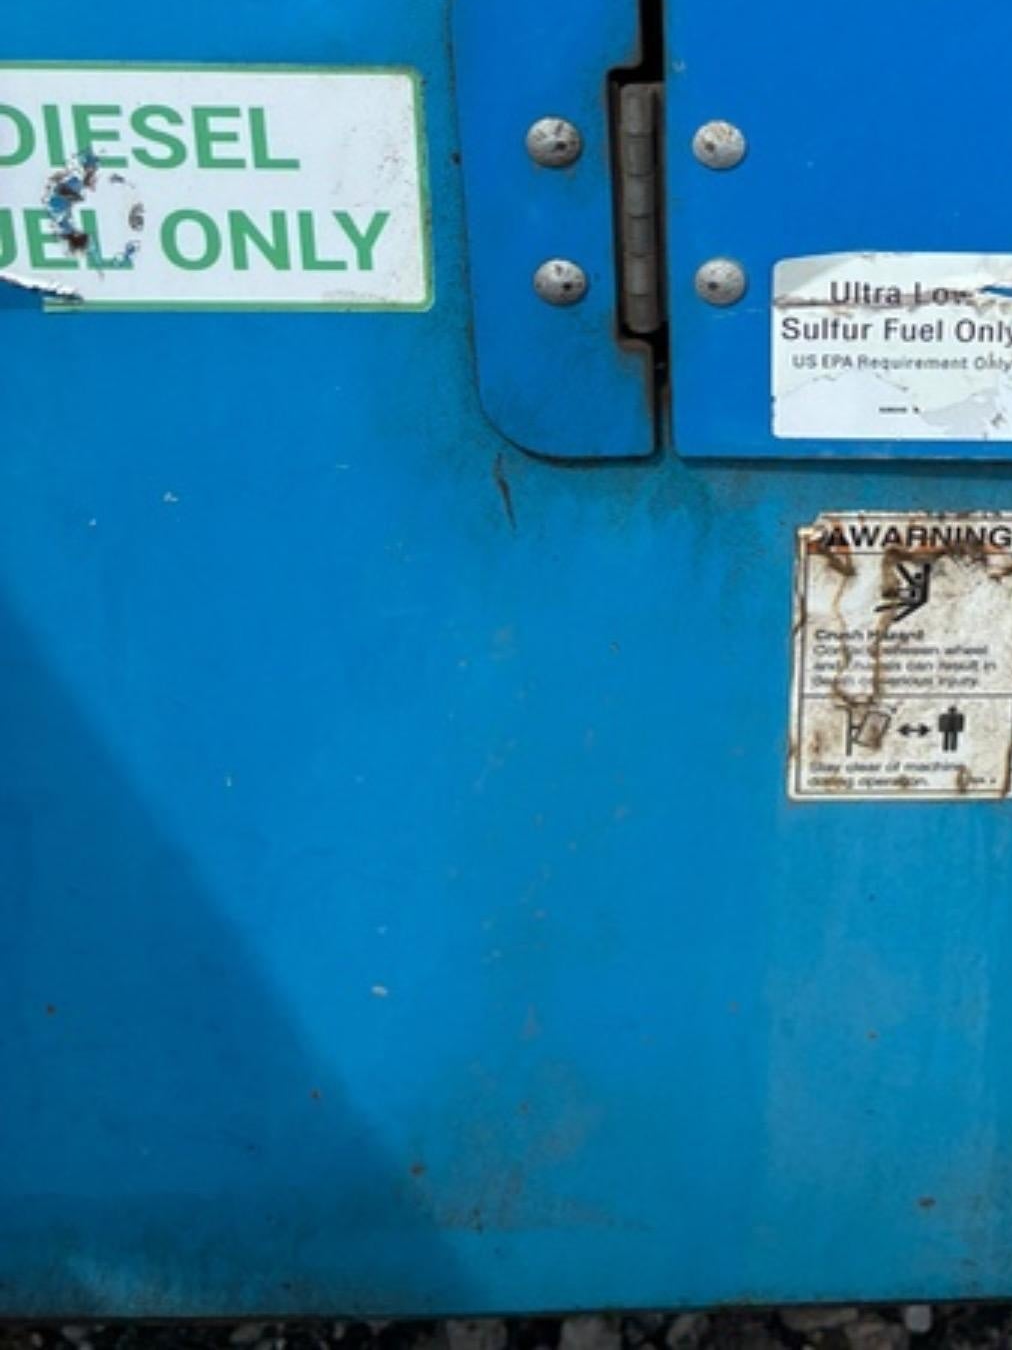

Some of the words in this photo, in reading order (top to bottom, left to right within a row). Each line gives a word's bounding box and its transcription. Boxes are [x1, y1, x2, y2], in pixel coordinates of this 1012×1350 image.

[160, 208, 391, 271] ONLY
[830, 281, 901, 305] Ultra
[781, 317, 873, 341] Sulfur
[884, 318, 943, 342] Fuel
[792, 353, 817, 370] US
[821, 354, 852, 370] EPA
[856, 354, 968, 372] Requirement
[849, 524, 1012, 548] WARNING
[867, 629, 925, 643] Hzard
